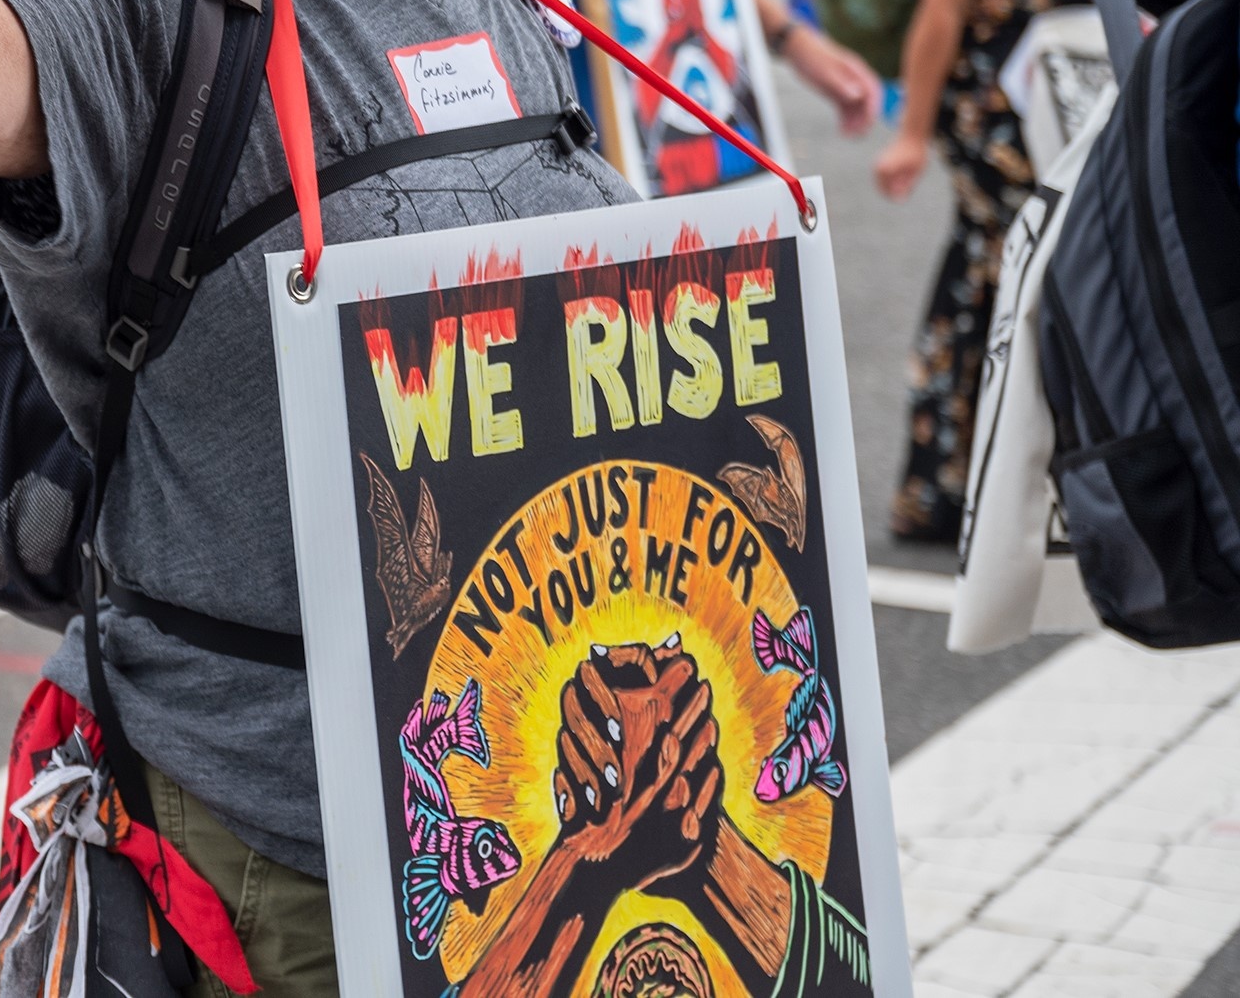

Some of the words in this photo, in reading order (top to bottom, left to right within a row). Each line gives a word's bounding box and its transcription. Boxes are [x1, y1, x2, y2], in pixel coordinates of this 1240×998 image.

[365, 307, 524, 470] WE
[564, 268, 782, 439] RISE
[453, 518, 533, 658] NOT
[552, 465, 657, 553] JUST
[677, 481, 761, 607] FOR
[518, 550, 595, 647] YOU
[609, 537, 632, 594] &
[645, 535, 698, 607] ME
